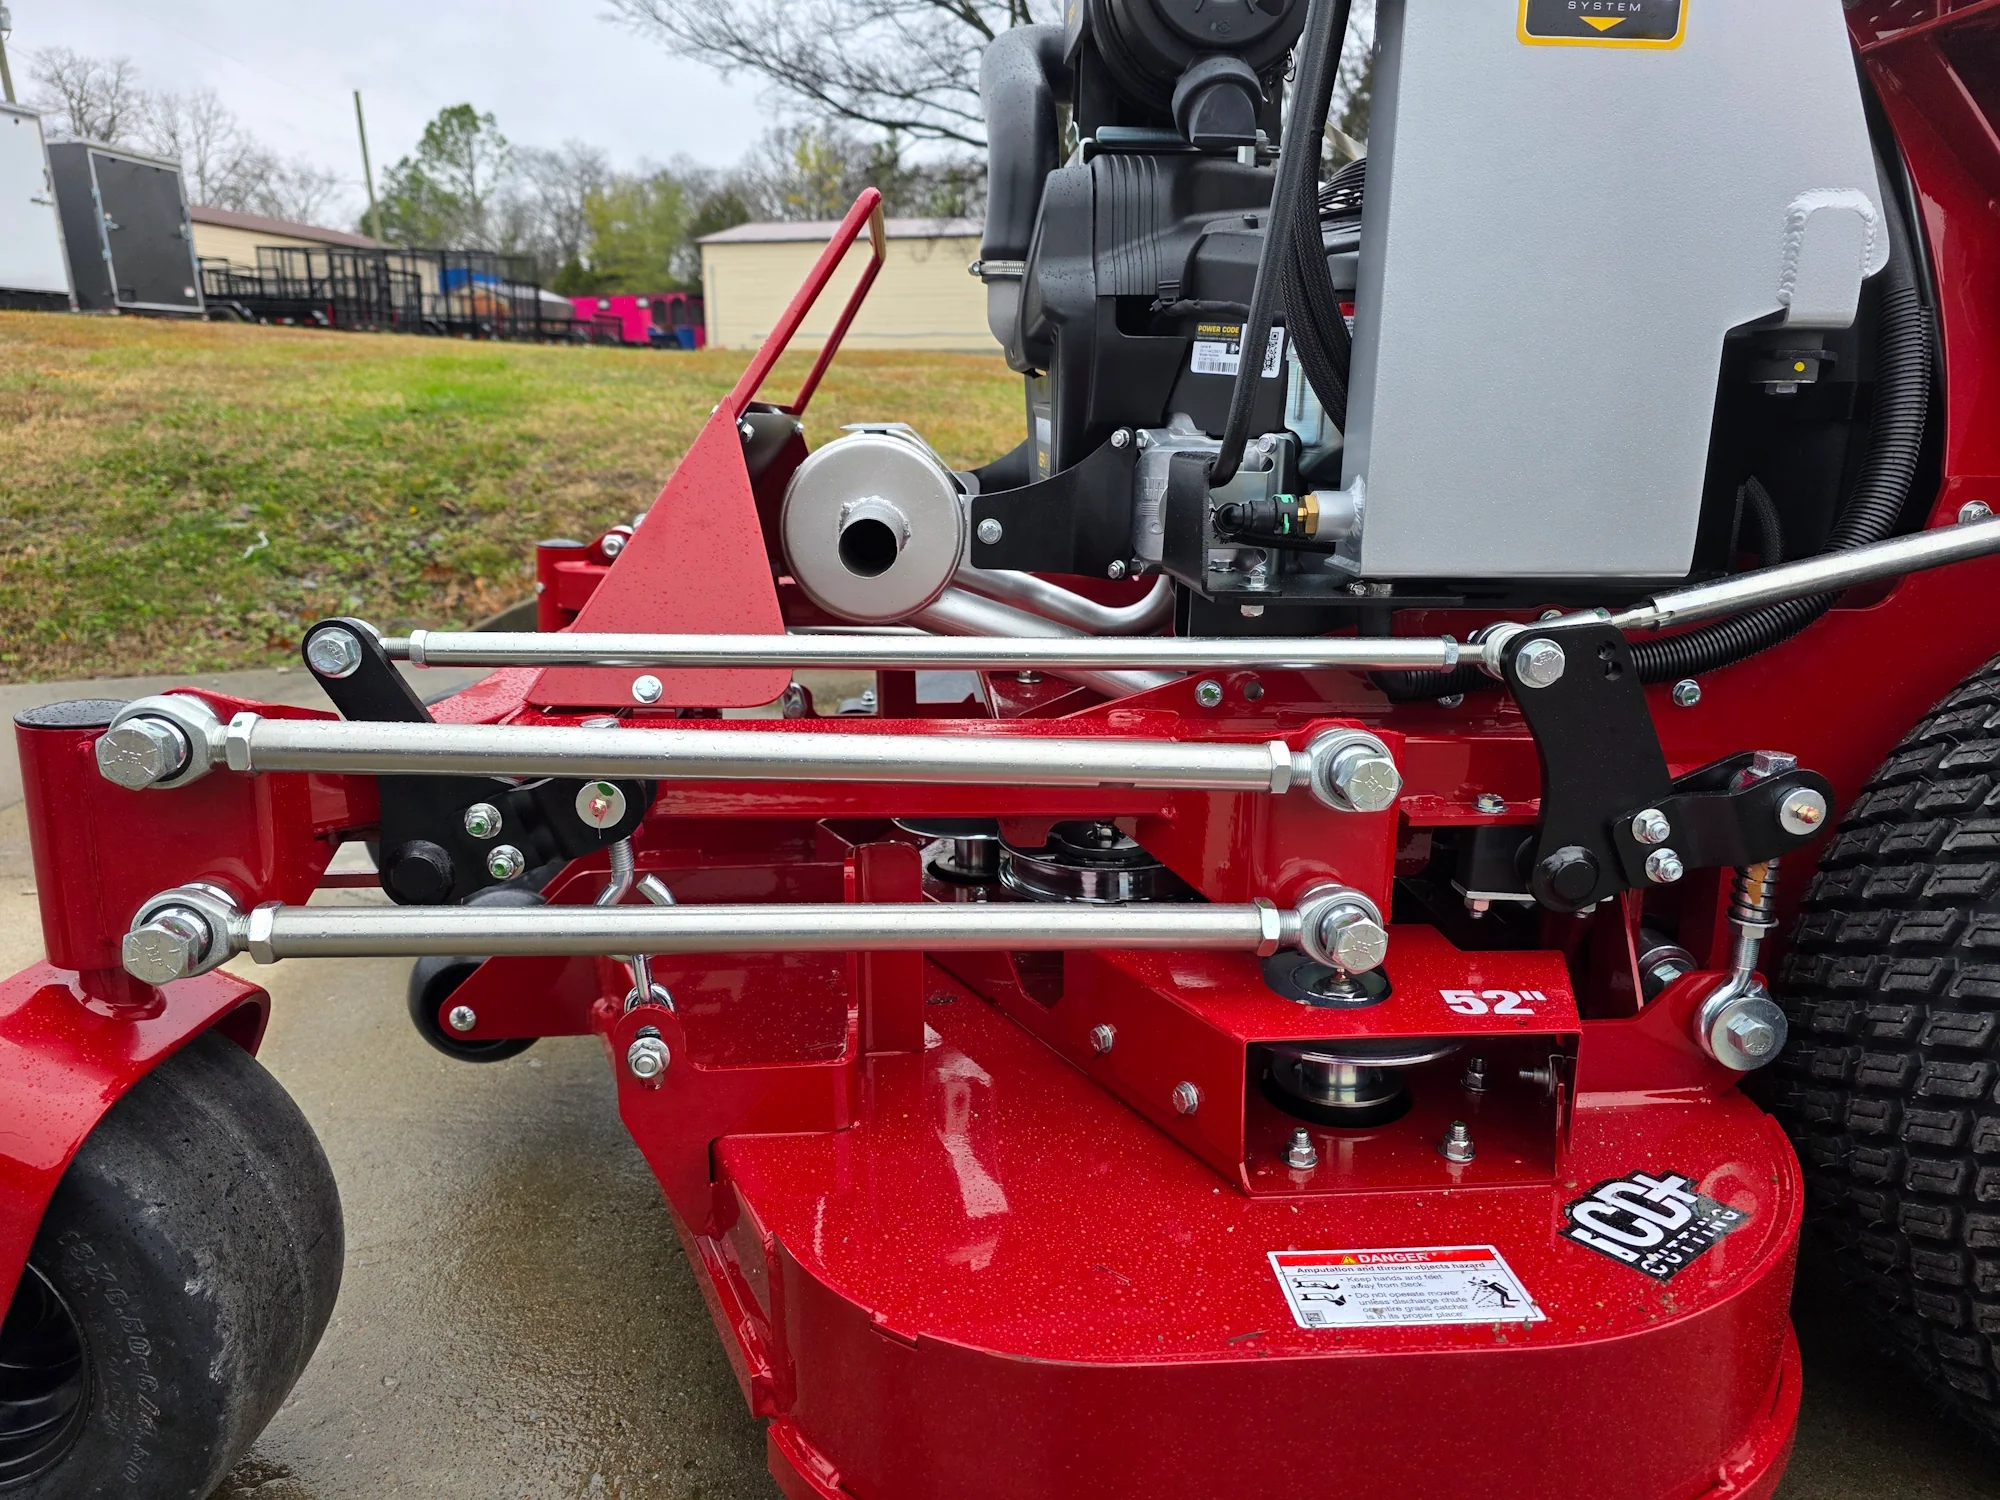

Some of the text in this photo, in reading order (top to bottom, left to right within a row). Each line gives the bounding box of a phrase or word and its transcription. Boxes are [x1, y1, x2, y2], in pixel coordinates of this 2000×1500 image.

[1567, 0, 1642, 12] SYSTEM
[1197, 325, 1240, 334] POWER CODE
[1438, 989, 1548, 1015] 52"
[1640, 1208, 1740, 1276] CUTTING
[1358, 1252, 1431, 1263] DANGER
[1358, 1298, 1390, 1306] unless
[1392, 1297, 1437, 1305] discharge
[1374, 1305, 1402, 1313] ntire
[1404, 1305, 1432, 1313] grass
[1402, 1312, 1433, 1320] proper
